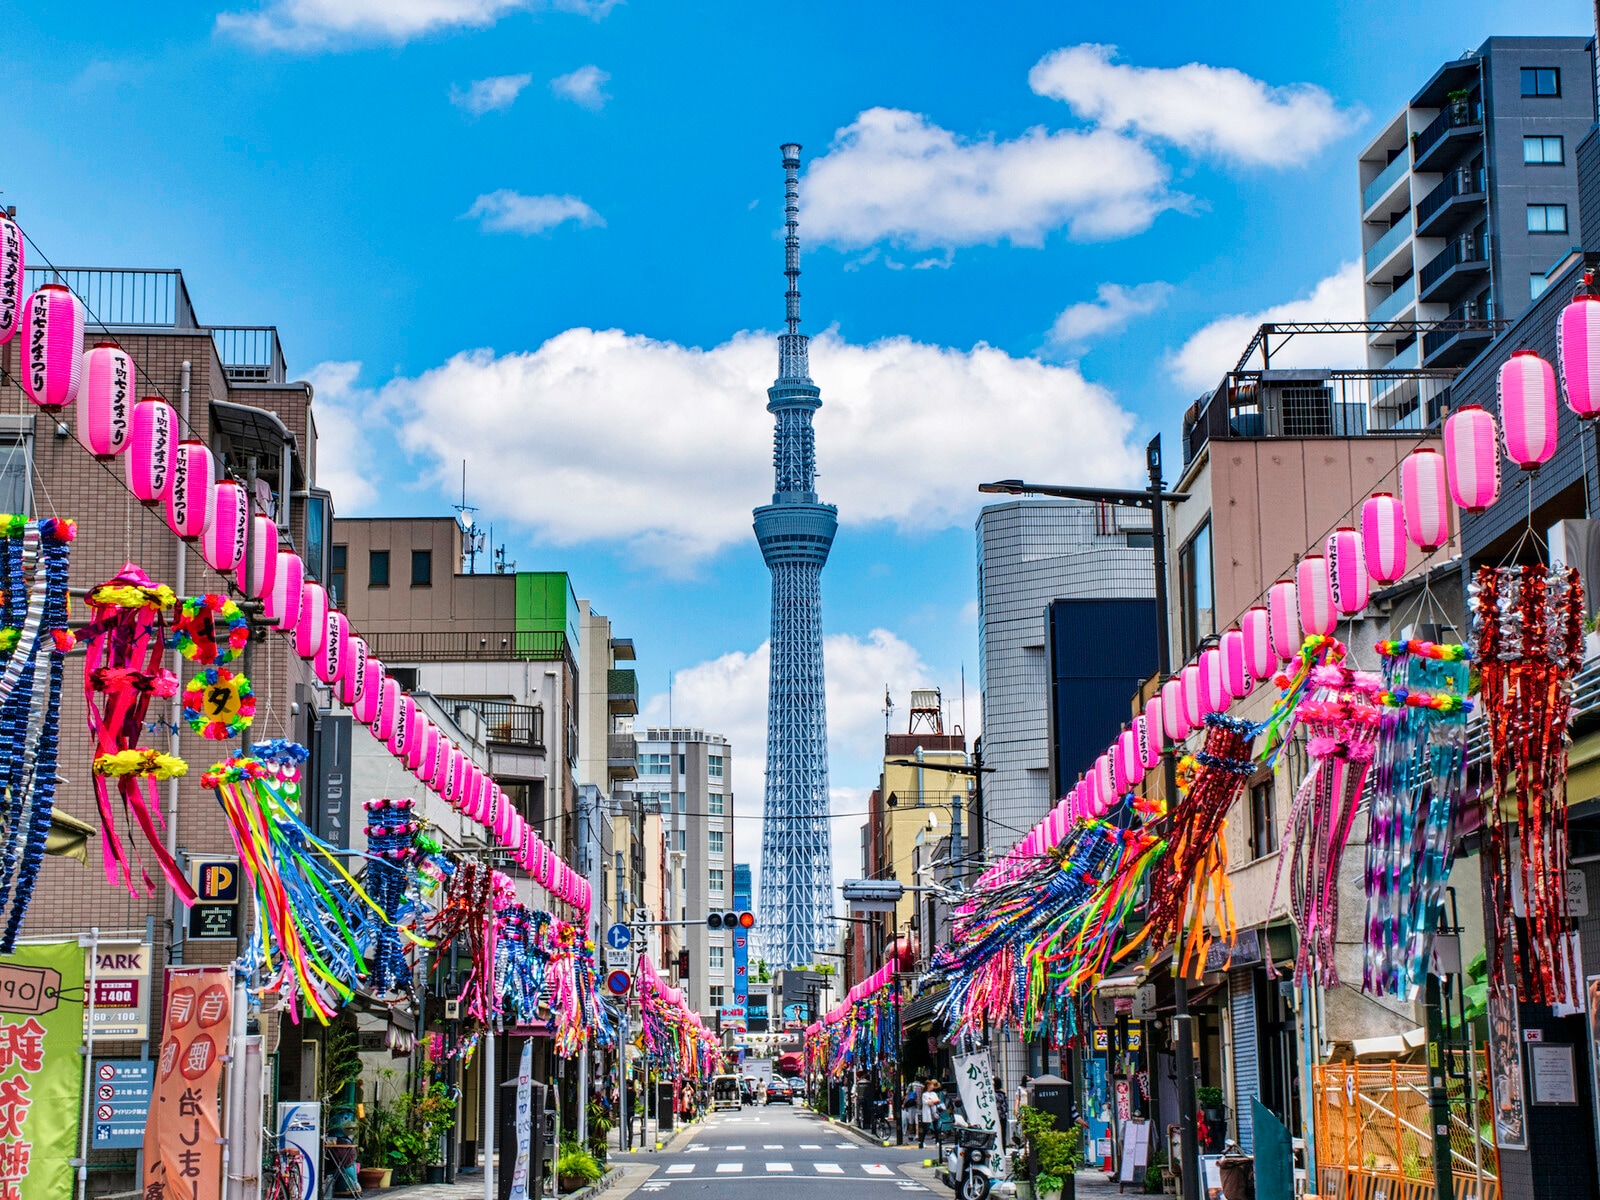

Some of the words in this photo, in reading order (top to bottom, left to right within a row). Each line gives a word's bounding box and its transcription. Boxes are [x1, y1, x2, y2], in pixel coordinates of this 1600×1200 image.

[2, 223, 19, 330] 下町七夕まつり
[31, 294, 48, 392] 下町七夕まつり
[112, 356, 128, 446] 下町七夕まつり
[153, 406, 169, 490] 下町七夕まつり
[175, 447, 187, 526] 下町七夕まつり
[1329, 536, 1341, 604] 下町七夕まつり
[328, 616, 339, 676] 下町七夕まつり
[355, 641, 365, 697] 下町七夕まつり
[1138, 718, 1148, 764] 下町七夕まつり
[211, 866, 232, 896] P
[201, 906, 232, 936] 空
[738, 1034, 795, 1043] 下町七夕まつり
